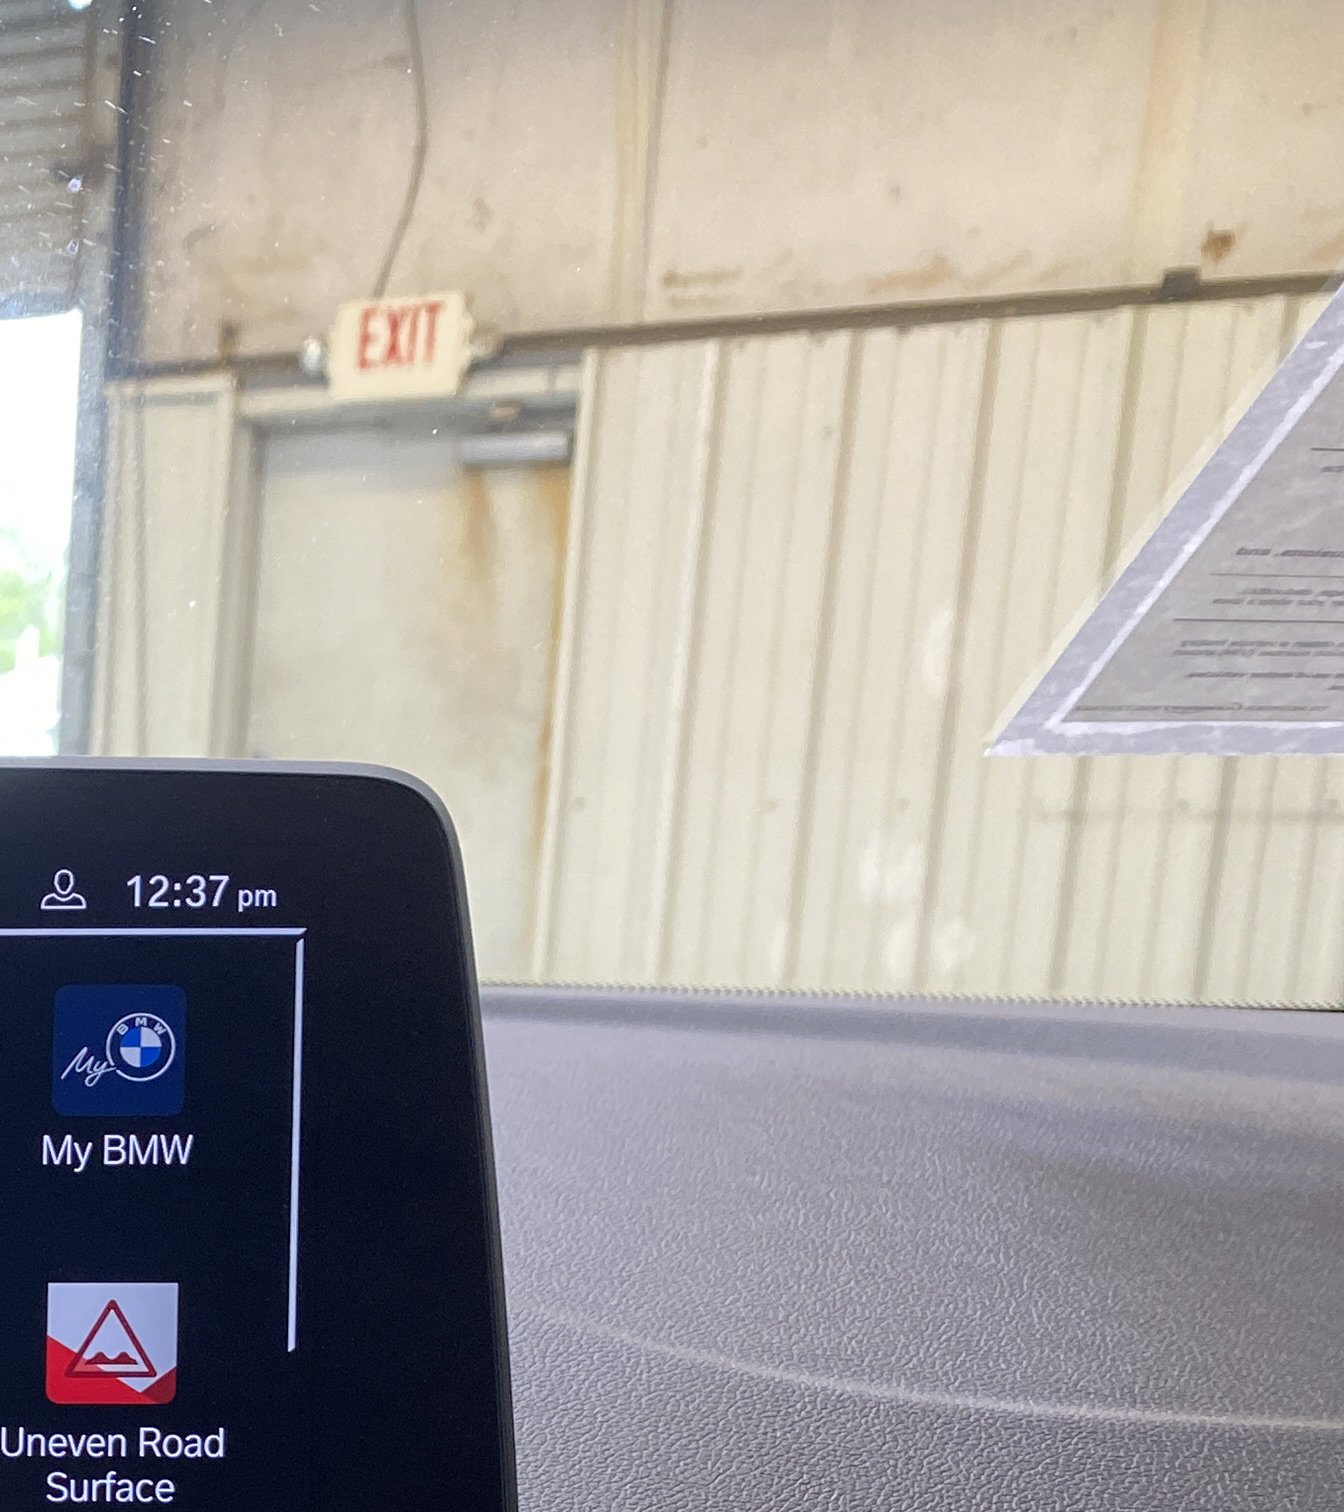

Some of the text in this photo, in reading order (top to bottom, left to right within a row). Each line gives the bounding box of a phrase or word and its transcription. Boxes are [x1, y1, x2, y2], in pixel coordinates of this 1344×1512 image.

[358, 301, 444, 370] EXIT
[126, 874, 277, 913] 12:37 pm
[60, 1016, 167, 1088] My BMW
[42, 1134, 194, 1173] My BMW
[0, 1426, 225, 1458] Uneven Road
[46, 1470, 175, 1503] Surface
